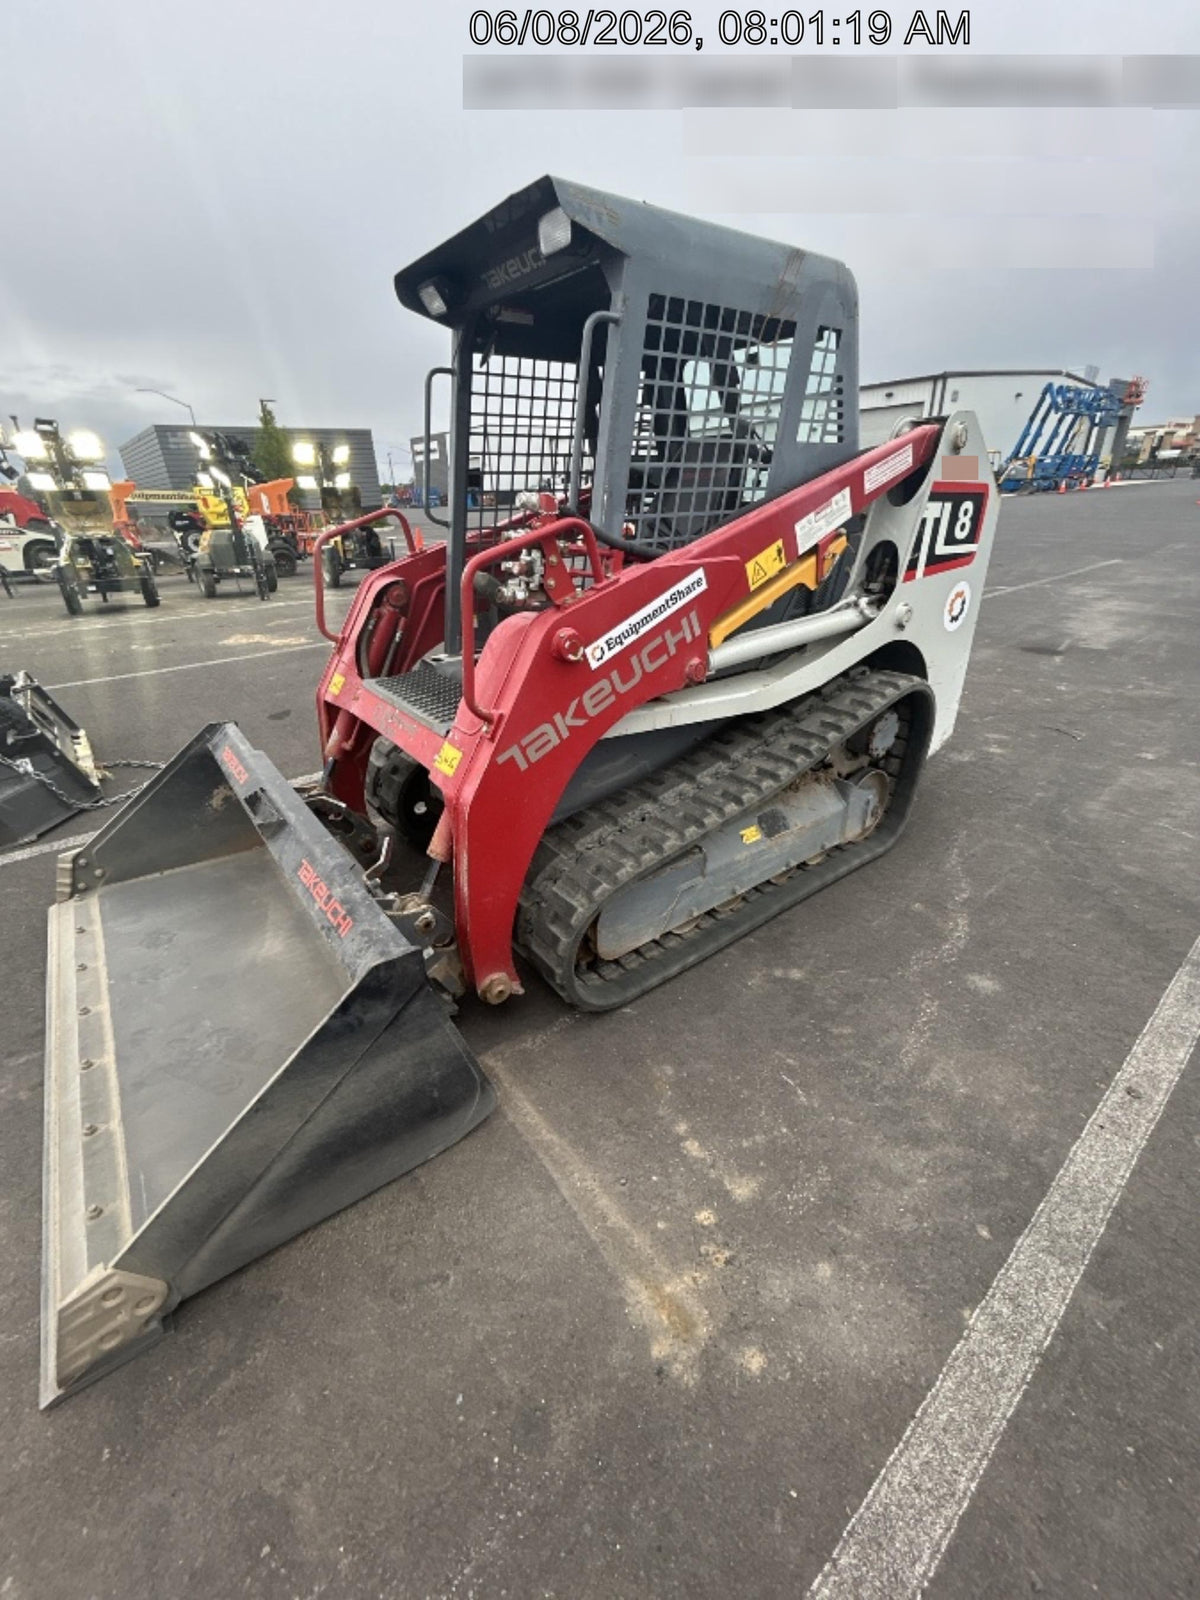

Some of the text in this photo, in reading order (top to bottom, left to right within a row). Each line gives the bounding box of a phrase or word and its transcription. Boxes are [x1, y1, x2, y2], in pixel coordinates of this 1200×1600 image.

[915, 501, 979, 580] TL8
[604, 576, 703, 652] EquipmentShare
[496, 609, 702, 771] TAKEUCHI
